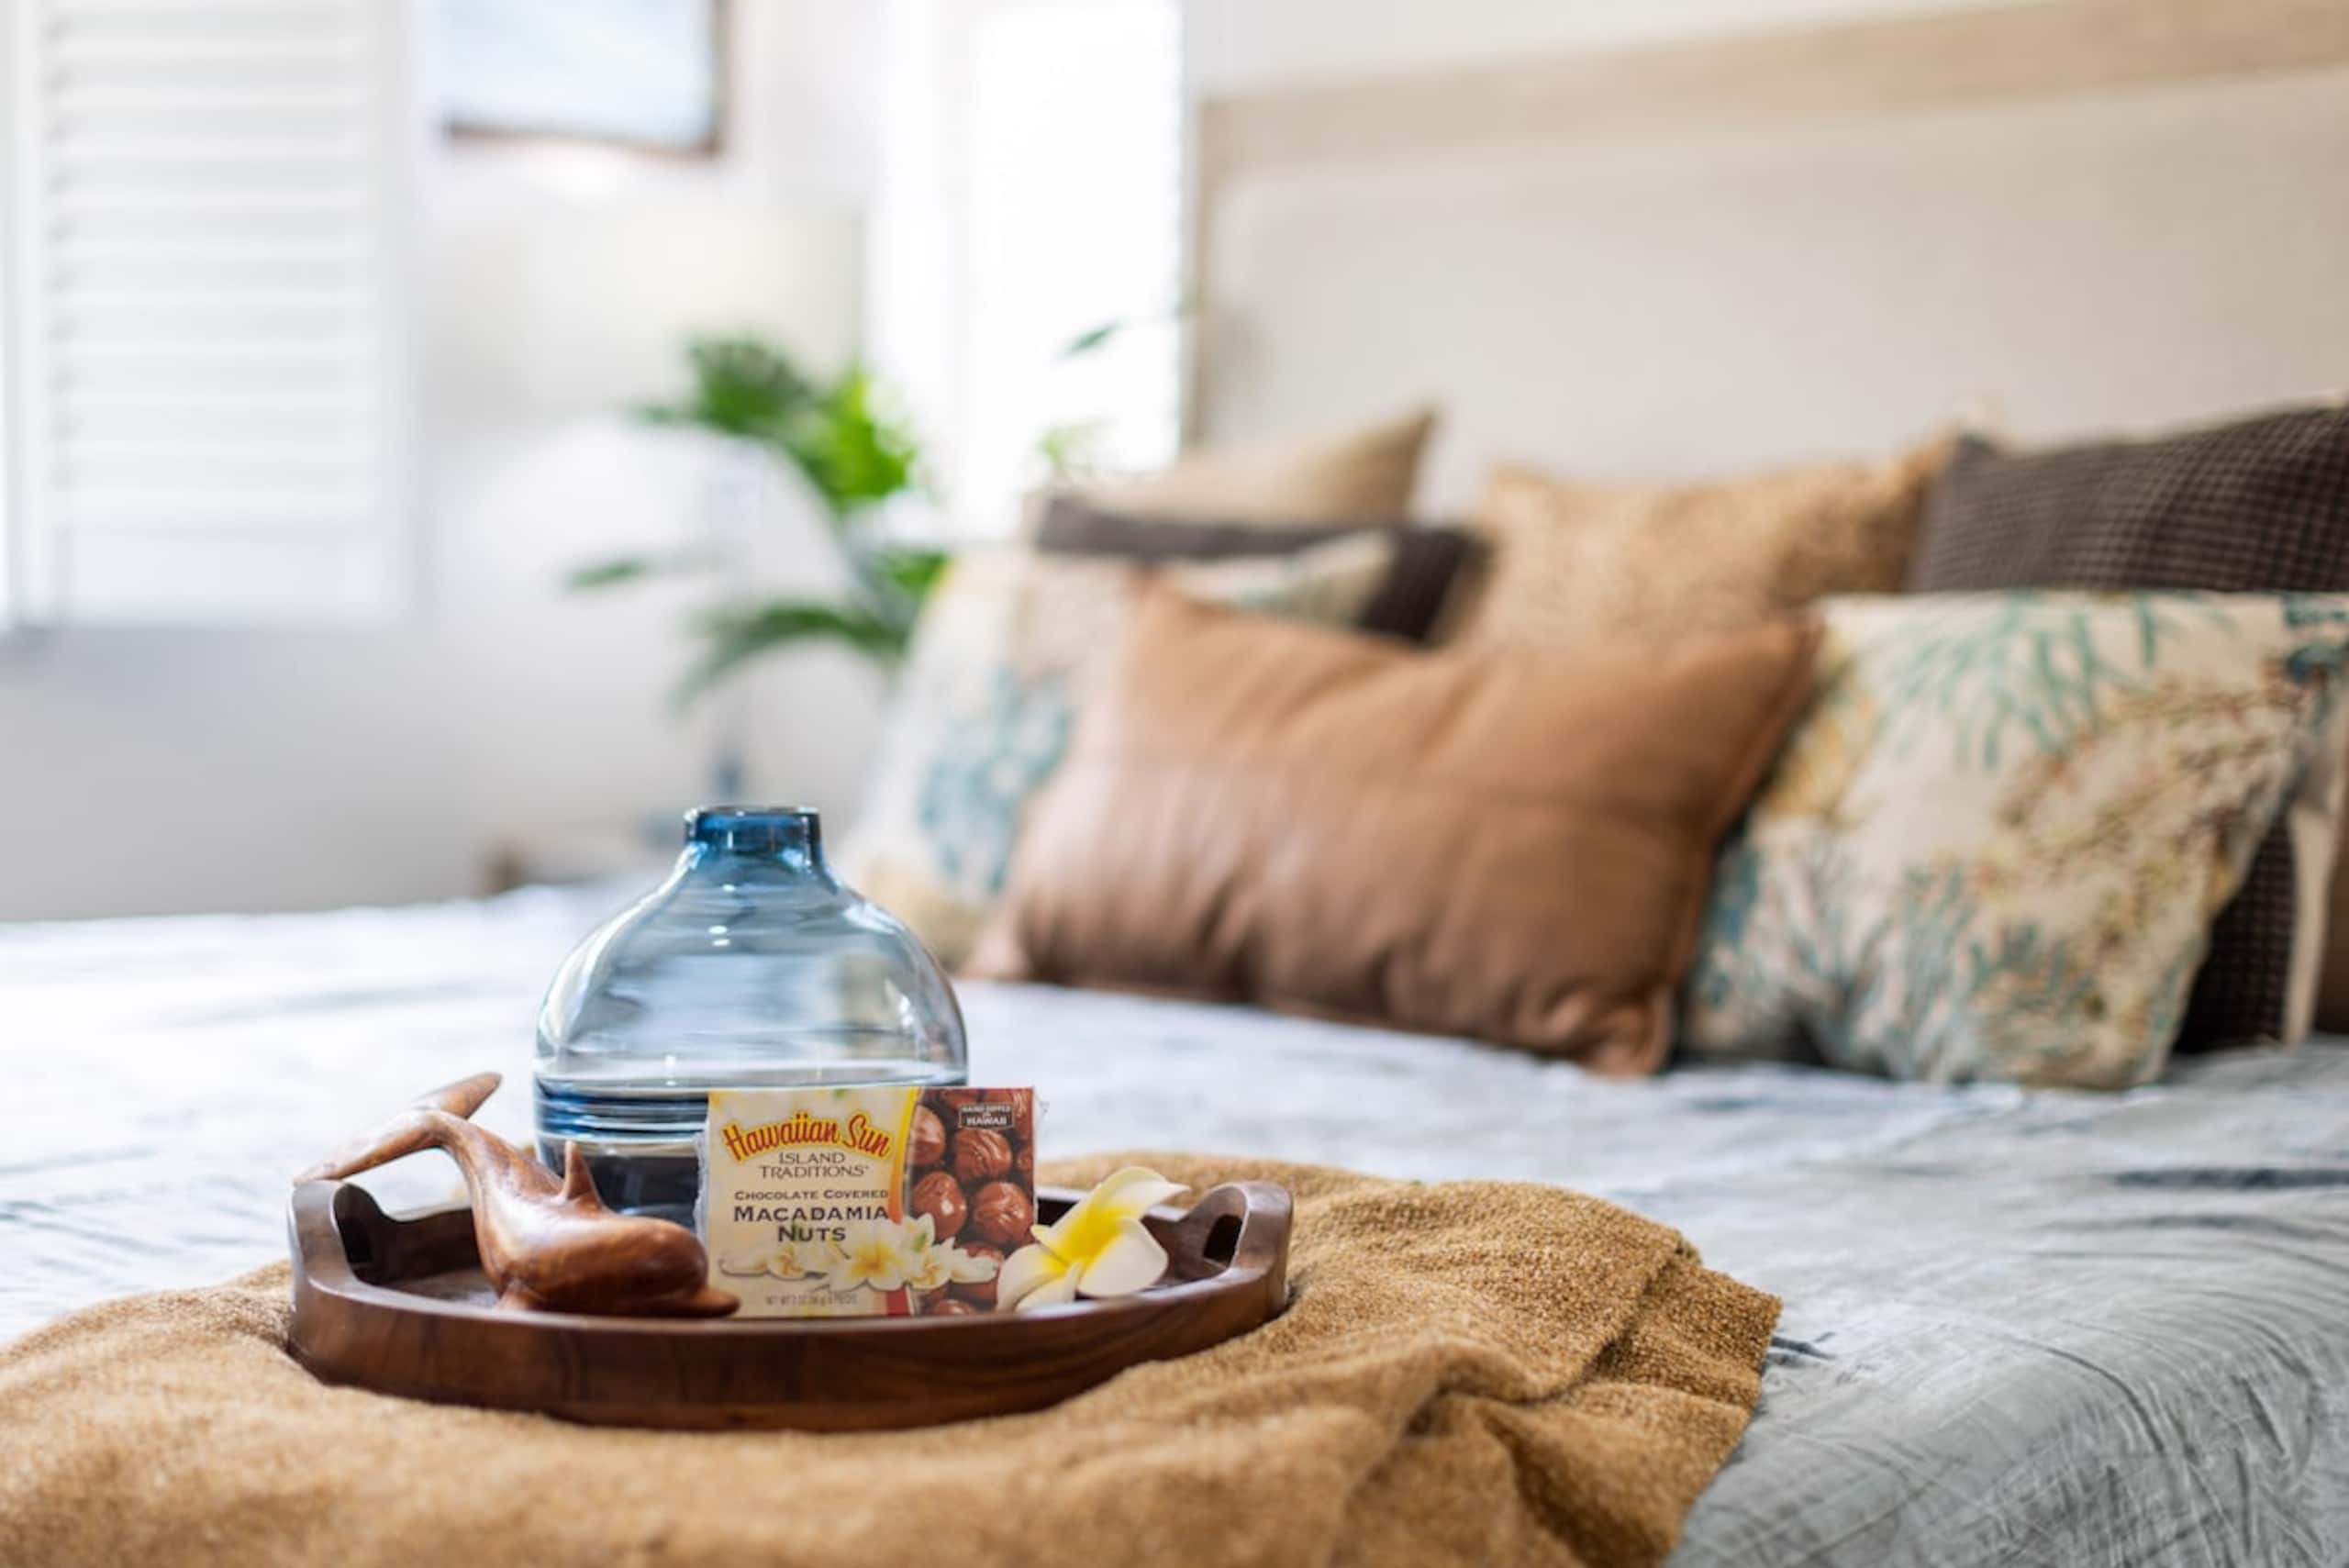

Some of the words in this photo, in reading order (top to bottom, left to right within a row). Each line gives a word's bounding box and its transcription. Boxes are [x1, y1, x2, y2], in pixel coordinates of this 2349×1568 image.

[966, 1116, 1008, 1127] HAWAII
[721, 1111, 840, 1162] Hawaiian
[842, 1112, 891, 1159] Sun
[779, 1151, 846, 1165] ISLAND
[734, 1190, 818, 1201] CHOCOLATE
[823, 1189, 889, 1200] COVERED
[733, 1205, 889, 1223] MACADAMIA
[777, 1226, 847, 1242] NUTS
